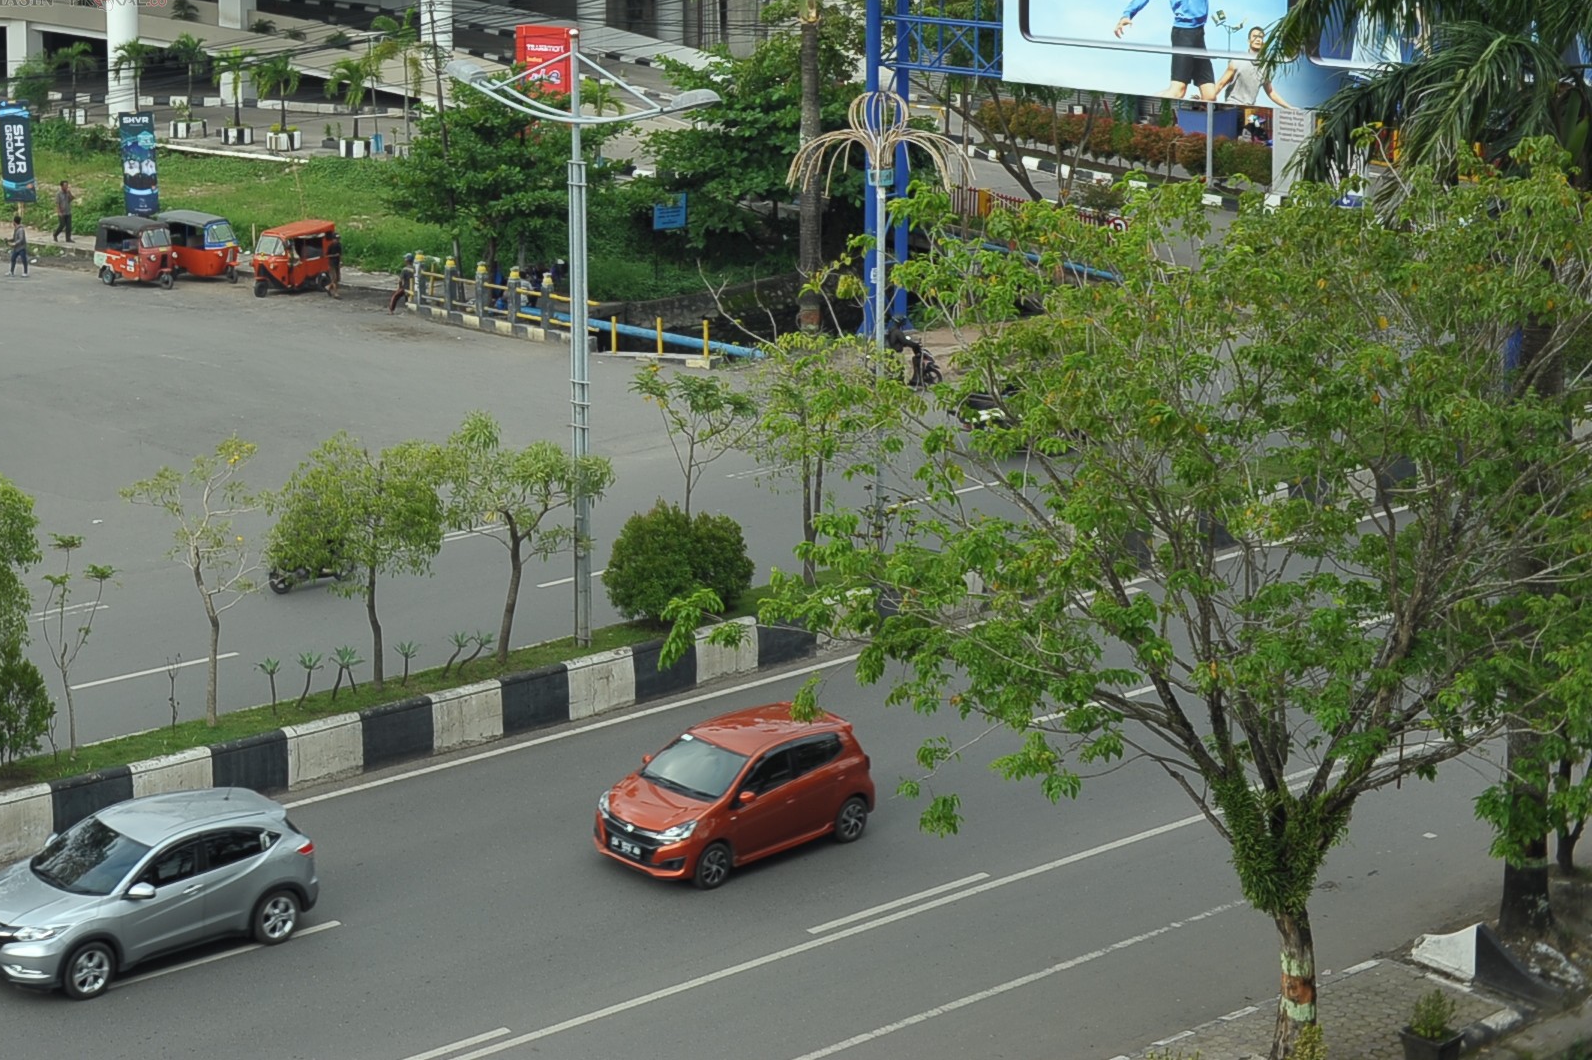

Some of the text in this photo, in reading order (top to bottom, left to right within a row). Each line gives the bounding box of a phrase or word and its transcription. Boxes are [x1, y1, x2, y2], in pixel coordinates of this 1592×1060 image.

[122, 116, 149, 124] SHVR
[4, 124, 16, 175] GROUND
[12, 124, 27, 174] SHVR
